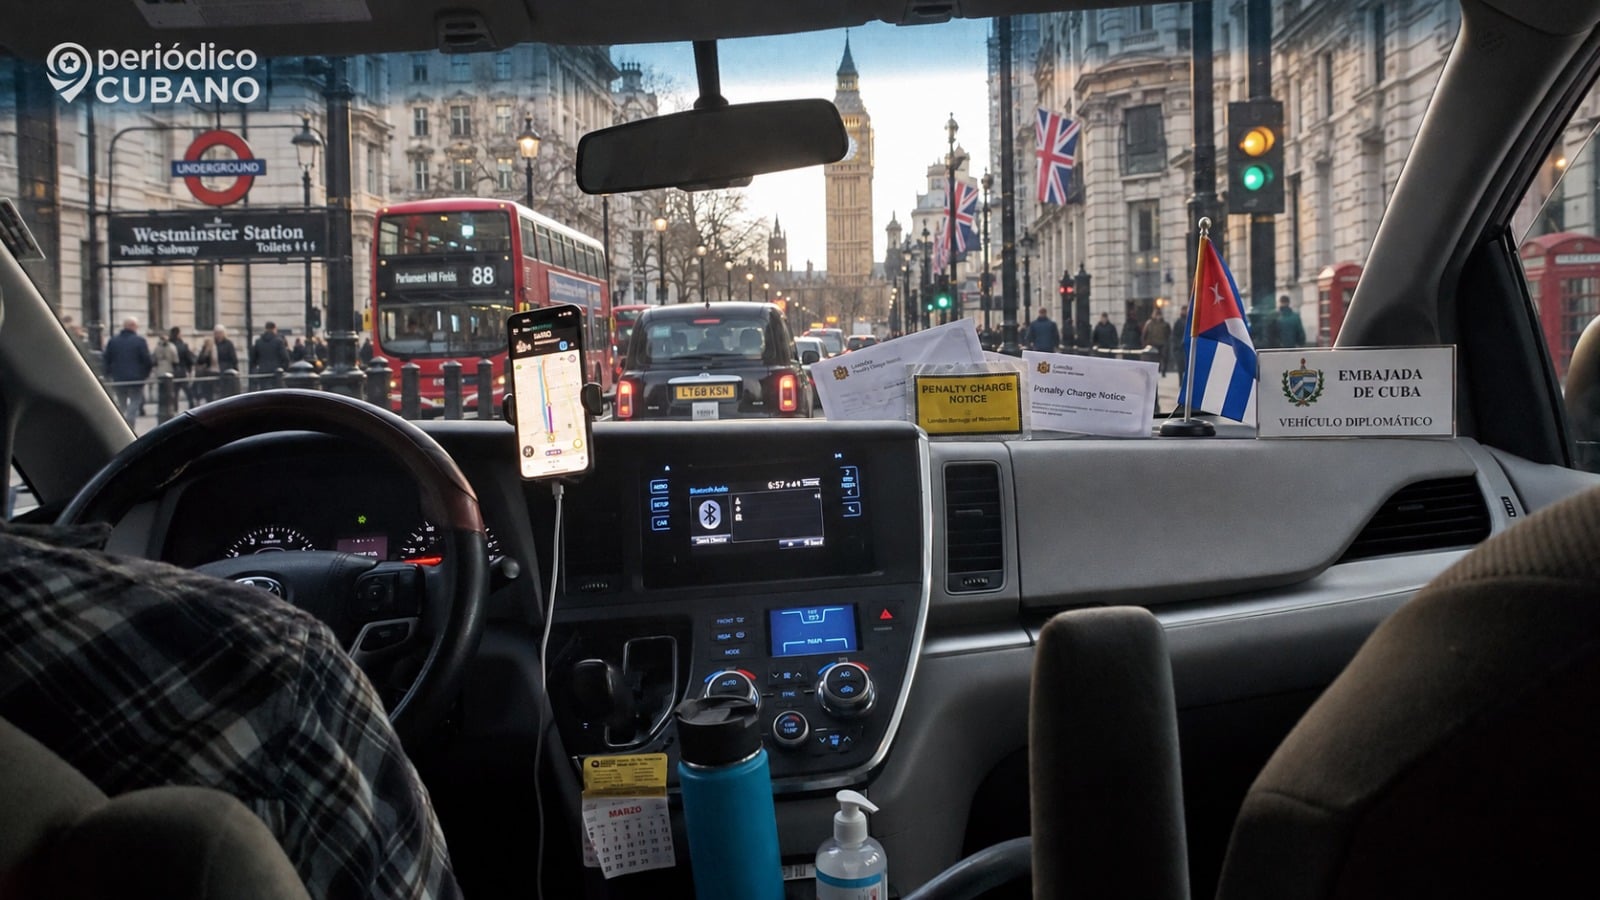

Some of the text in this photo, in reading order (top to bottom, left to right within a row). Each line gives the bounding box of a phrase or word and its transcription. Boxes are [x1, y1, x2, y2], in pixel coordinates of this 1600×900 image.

[176, 162, 260, 174] UNDERGROUND
[132, 225, 239, 242] Westminster
[243, 224, 304, 241] Station
[120, 243, 199, 258] Public Subway
[256, 242, 292, 253] Toilets
[472, 266, 494, 285] 88
[1338, 368, 1423, 382] EMBAJADA
[681, 385, 729, 397] LT68 KSN
[922, 383, 1013, 394] PENALTY CHARGE
[1033, 384, 1126, 402] Penalty Charge Notice
[1353, 386, 1422, 399] DE CUBA
[949, 394, 988, 404] NOTICE
[1279, 414, 1433, 428] VEHÍCULO DIPLOMÁTICO
[609, 805, 642, 818] MARZO
